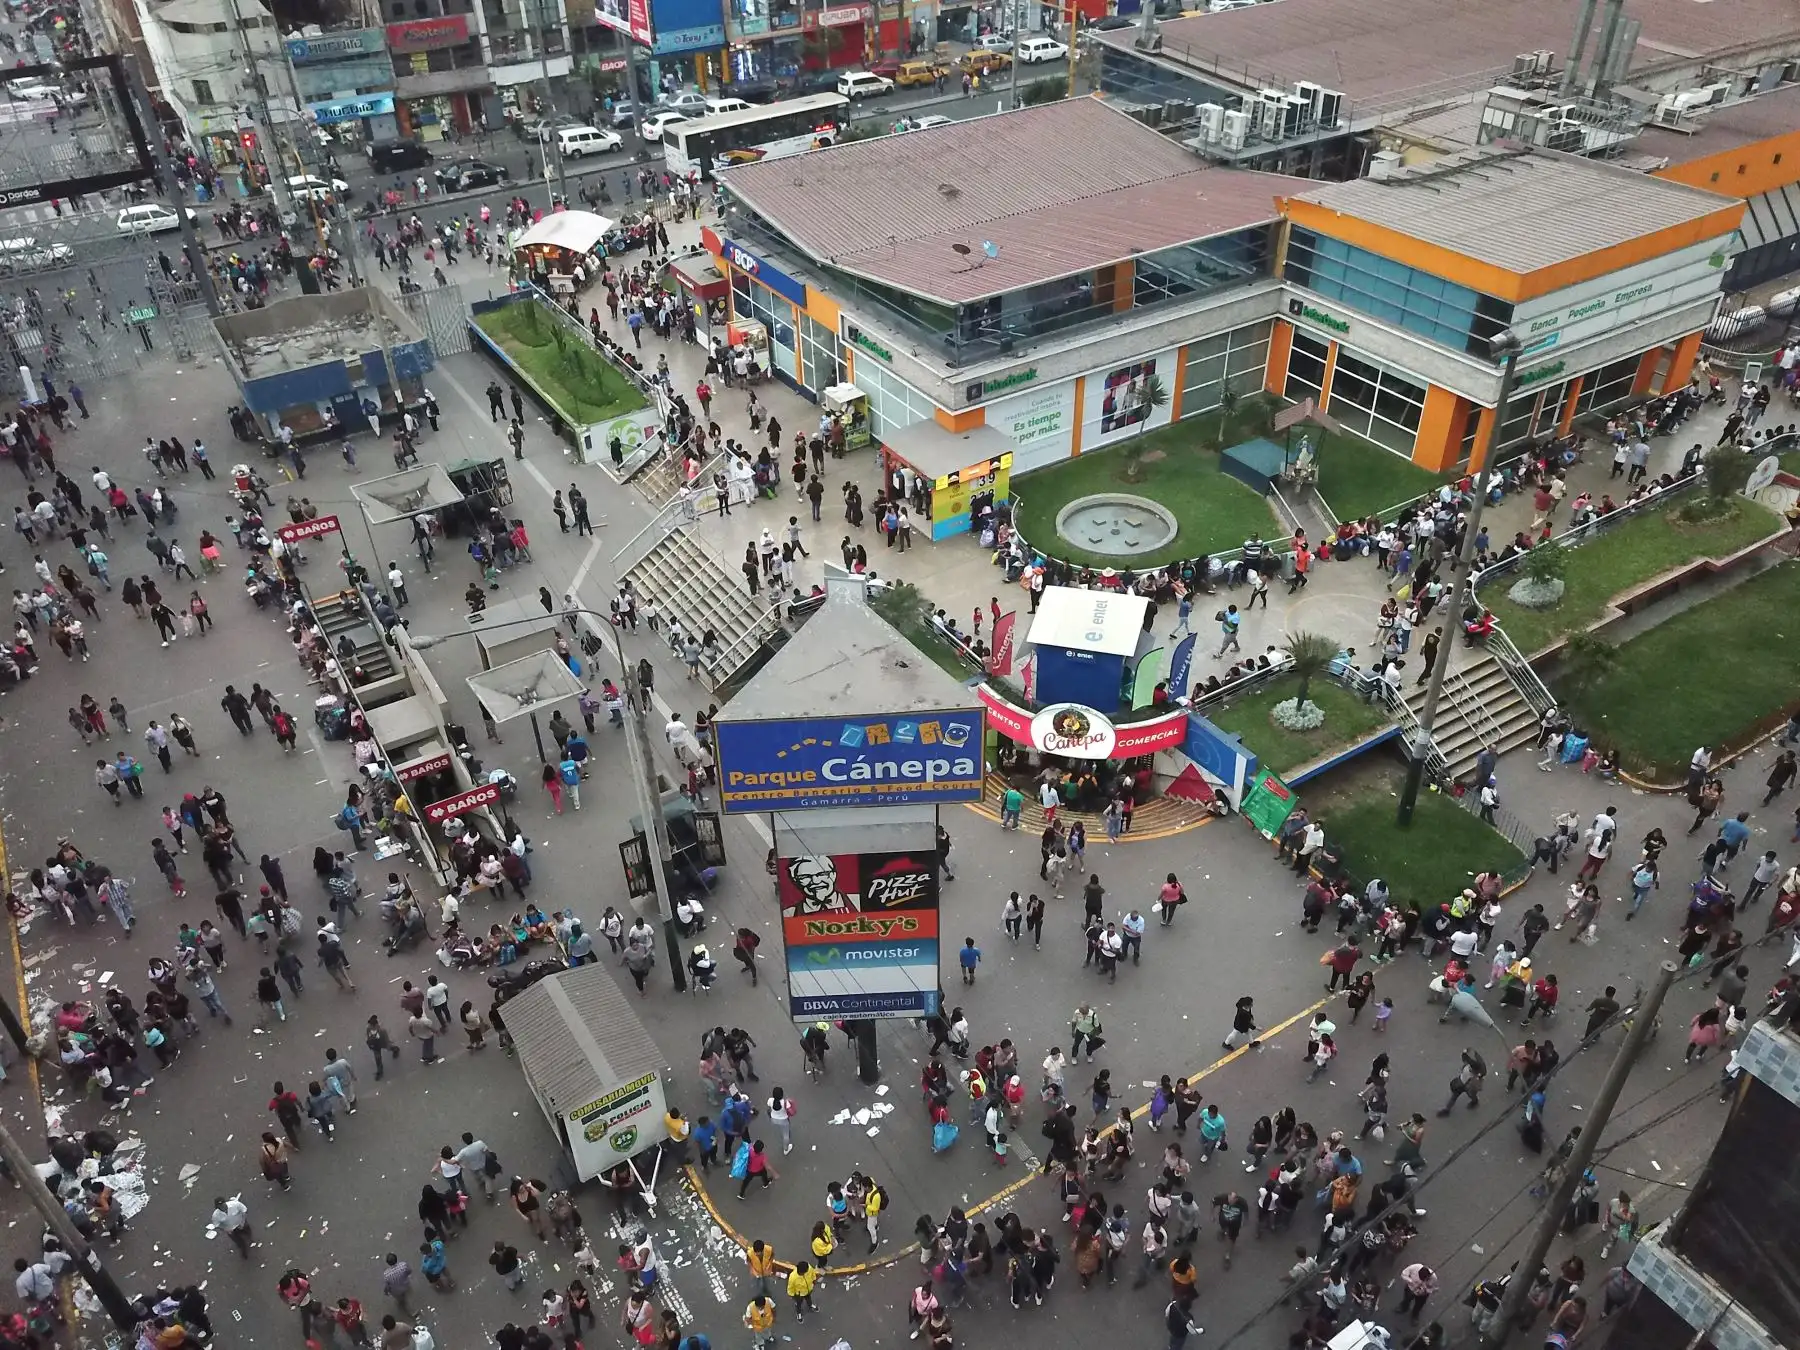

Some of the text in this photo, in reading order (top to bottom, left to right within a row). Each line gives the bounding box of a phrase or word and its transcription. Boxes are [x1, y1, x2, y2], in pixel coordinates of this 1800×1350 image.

[7, 188, 40, 200] Dardos
[734, 247, 755, 272] BCP
[130, 307, 155, 321] SALIDA
[1530, 283, 1653, 333] Banca Pequeña Empresa
[1013, 411, 1062, 432] Es tiempo
[1019, 421, 1061, 443] por más.
[296, 520, 336, 536] BAÑOS
[1093, 600, 1109, 625] entel
[987, 706, 1021, 730] CENTRO
[1118, 728, 1180, 748] COMERCIAL
[411, 758, 449, 777] BAÑOS
[728, 755, 974, 786] Parque Cánepa
[446, 789, 497, 813] BAÑOS
[731, 781, 975, 801] Centro Bancario & Food Court
[801, 796, 860, 806] Gamarra
[878, 793, 908, 802] Perú
[868, 873, 932, 899] Pizza
[879, 884, 925, 903] Hut
[805, 916, 918, 937] Norky's
[845, 947, 919, 960] movistar
[803, 1000, 840, 1011] BBVA
[842, 997, 915, 1008] Continental
[569, 1087, 626, 1121] COMISARIA
[625, 1072, 657, 1094] MOVIL
